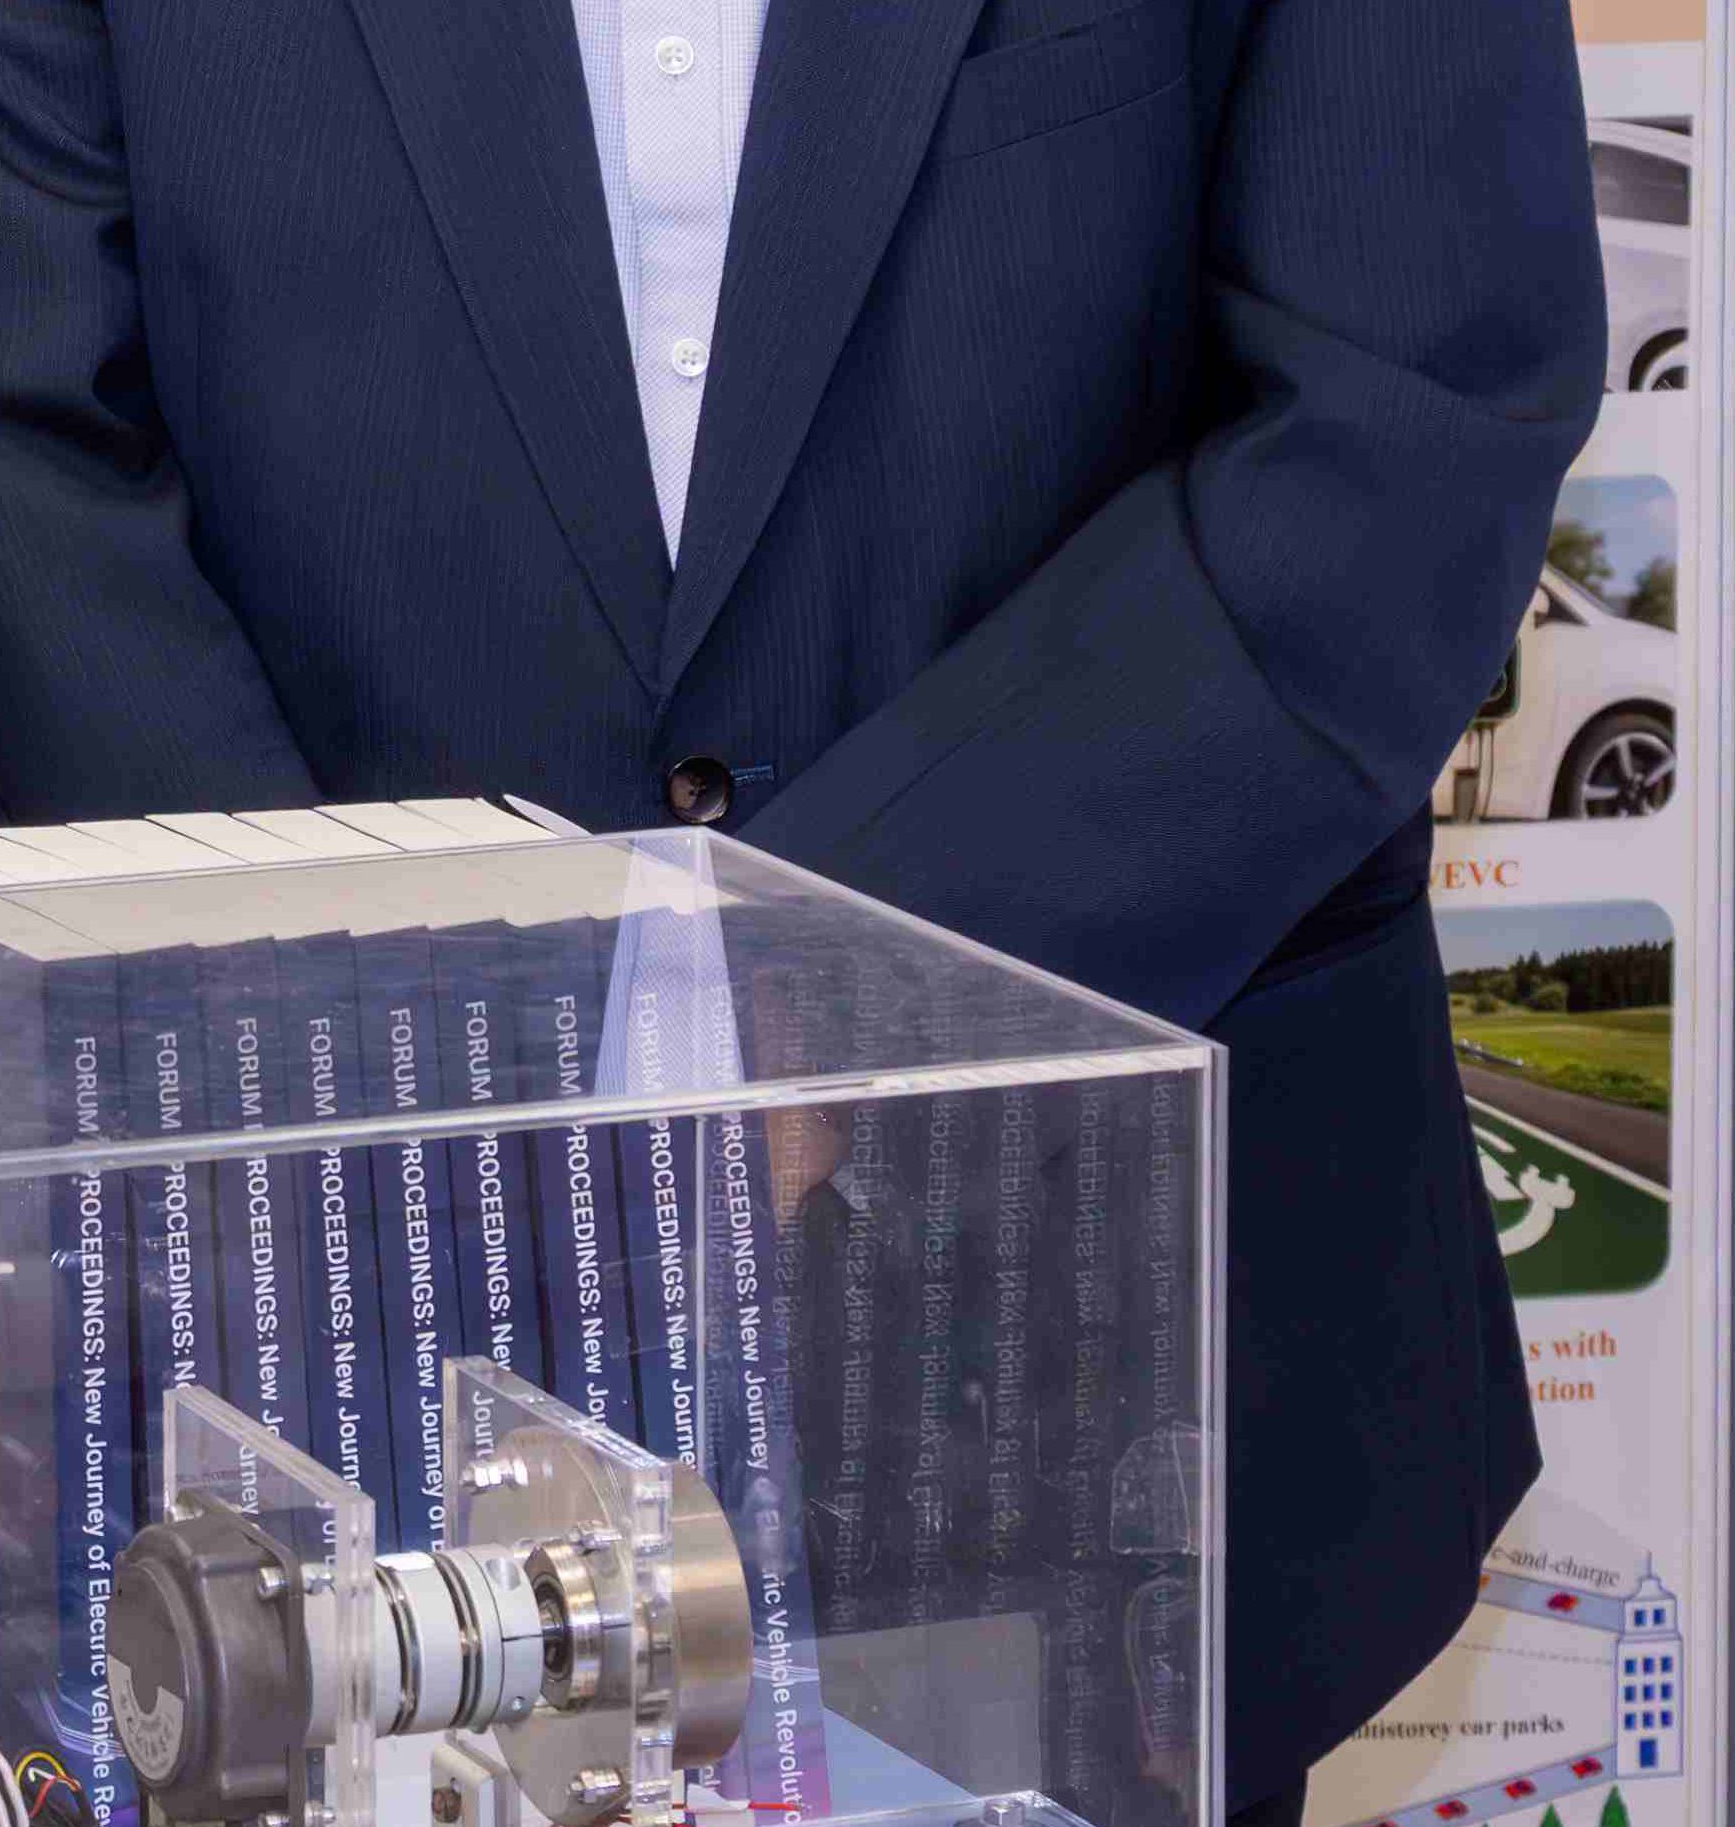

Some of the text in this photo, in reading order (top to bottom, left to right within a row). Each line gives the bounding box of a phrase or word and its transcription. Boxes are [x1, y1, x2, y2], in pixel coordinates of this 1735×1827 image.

[74, 1037, 99, 1133] FORUM
[309, 1017, 337, 1117] FORUM
[333, 1342, 355, 1400] New
[555, 994, 582, 1095] FORUM
[581, 1317, 603, 1375] New
[84, 1368, 107, 1426] New
[738, 1306, 770, 1471] New Journey
[83, 1433, 107, 1537] Journey
[88, 1544, 106, 1571] of
[88, 1578, 107, 1676] Electric
